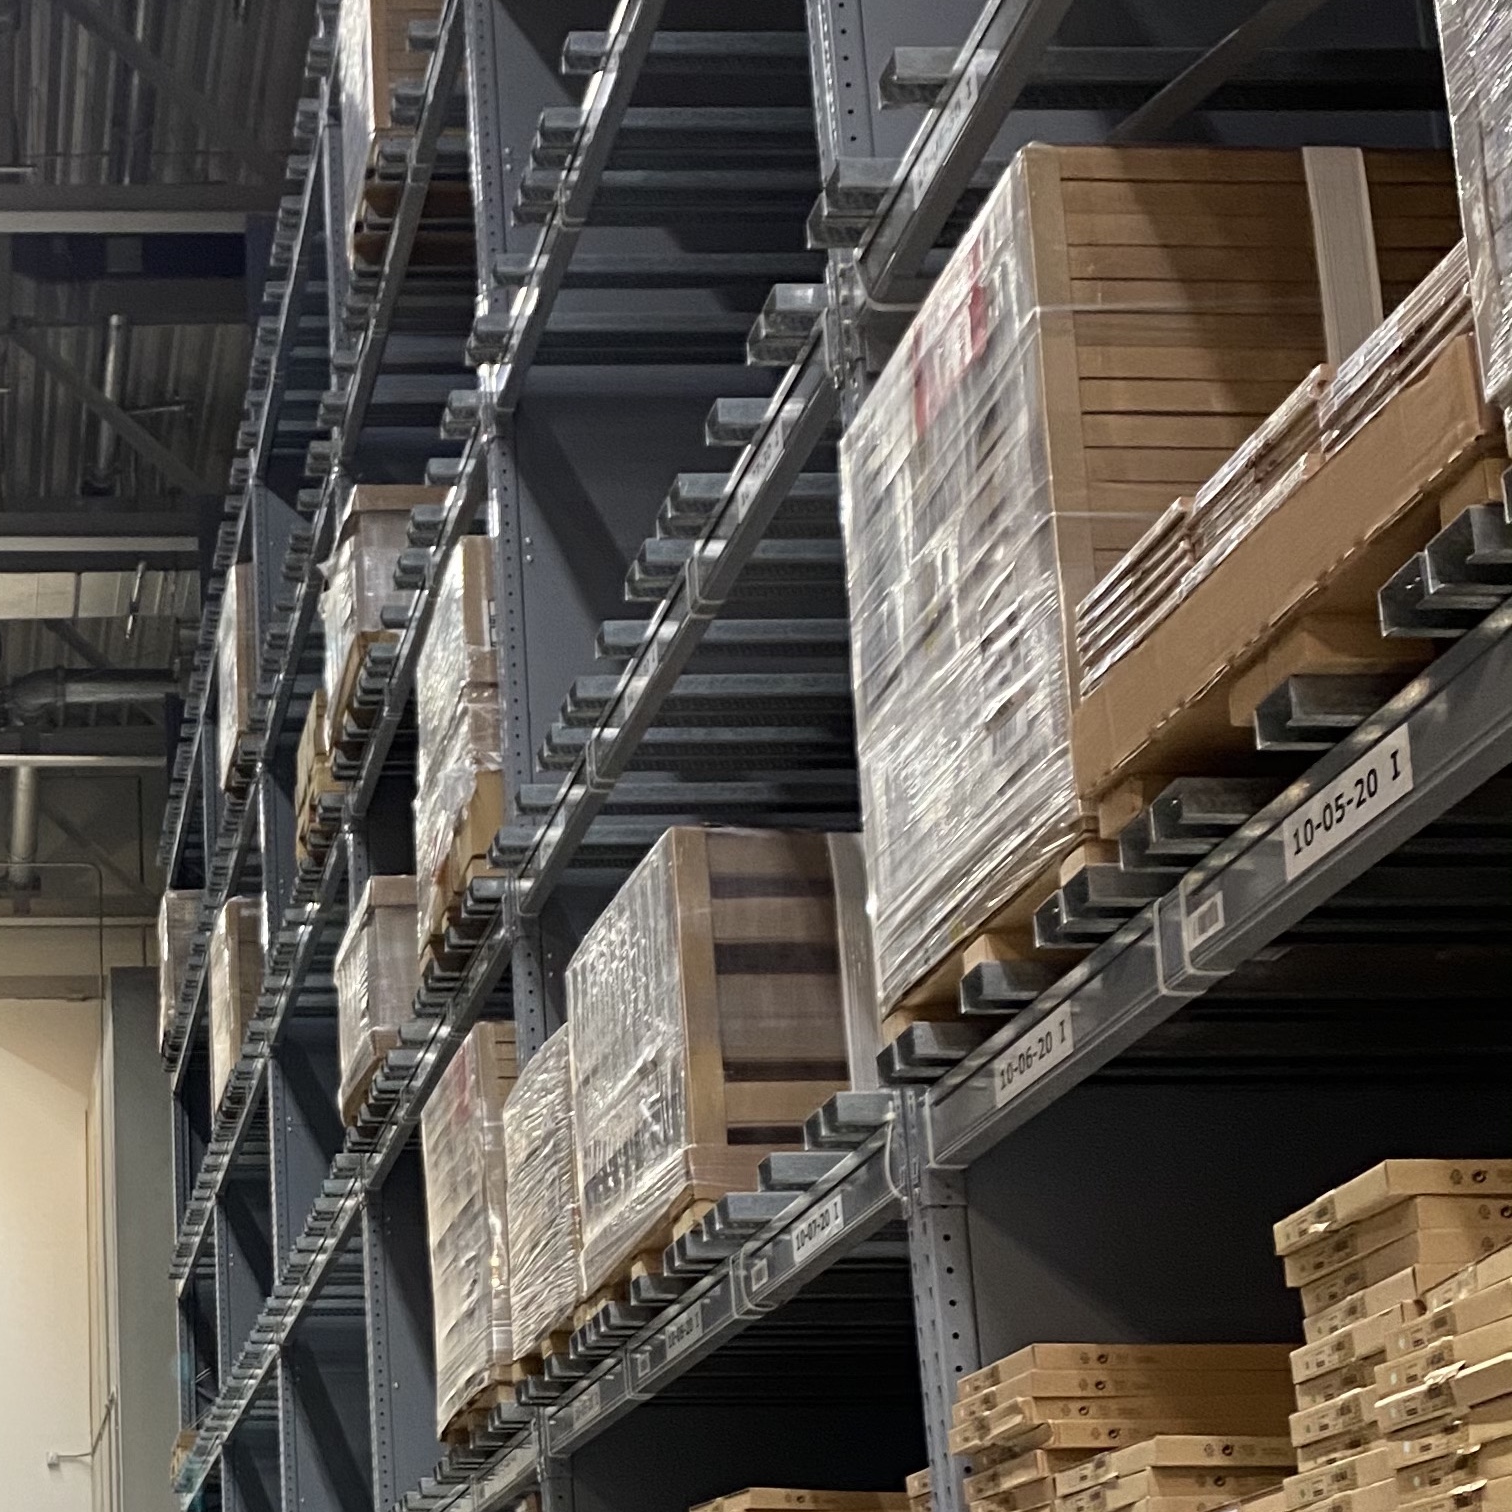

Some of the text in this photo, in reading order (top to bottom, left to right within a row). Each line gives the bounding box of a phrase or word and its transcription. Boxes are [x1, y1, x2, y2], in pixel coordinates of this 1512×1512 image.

[1292, 749, 1401, 856] 10-05-20 I
[999, 1018, 1067, 1091] 10-06-20 I
[795, 1212, 831, 1251] 10-07-20
